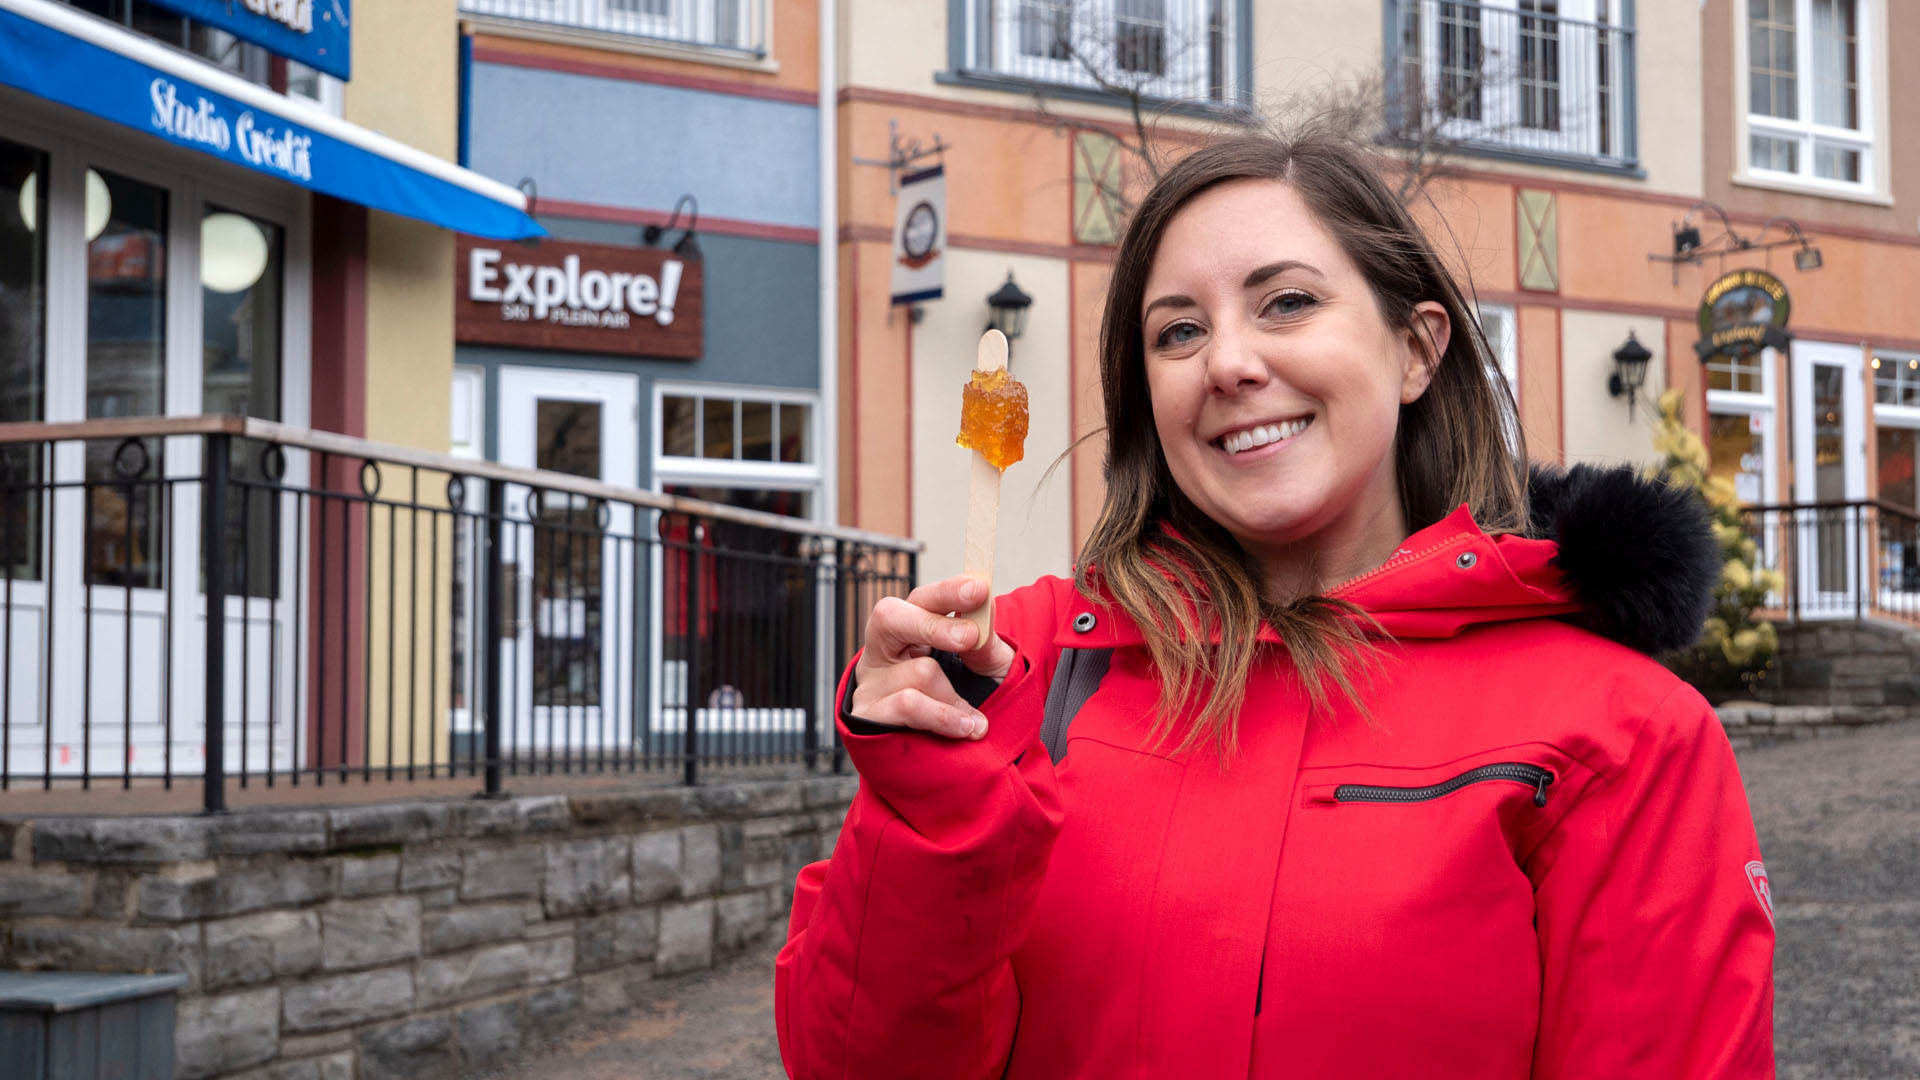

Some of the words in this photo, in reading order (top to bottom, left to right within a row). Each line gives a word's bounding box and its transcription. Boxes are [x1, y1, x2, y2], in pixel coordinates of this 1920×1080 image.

[151, 78, 230, 152] Studio
[470, 248, 683, 326] Explore!
[502, 303, 530, 321] SKI
[550, 307, 599, 327] PLEIN
[600, 311, 630, 329] AIR
